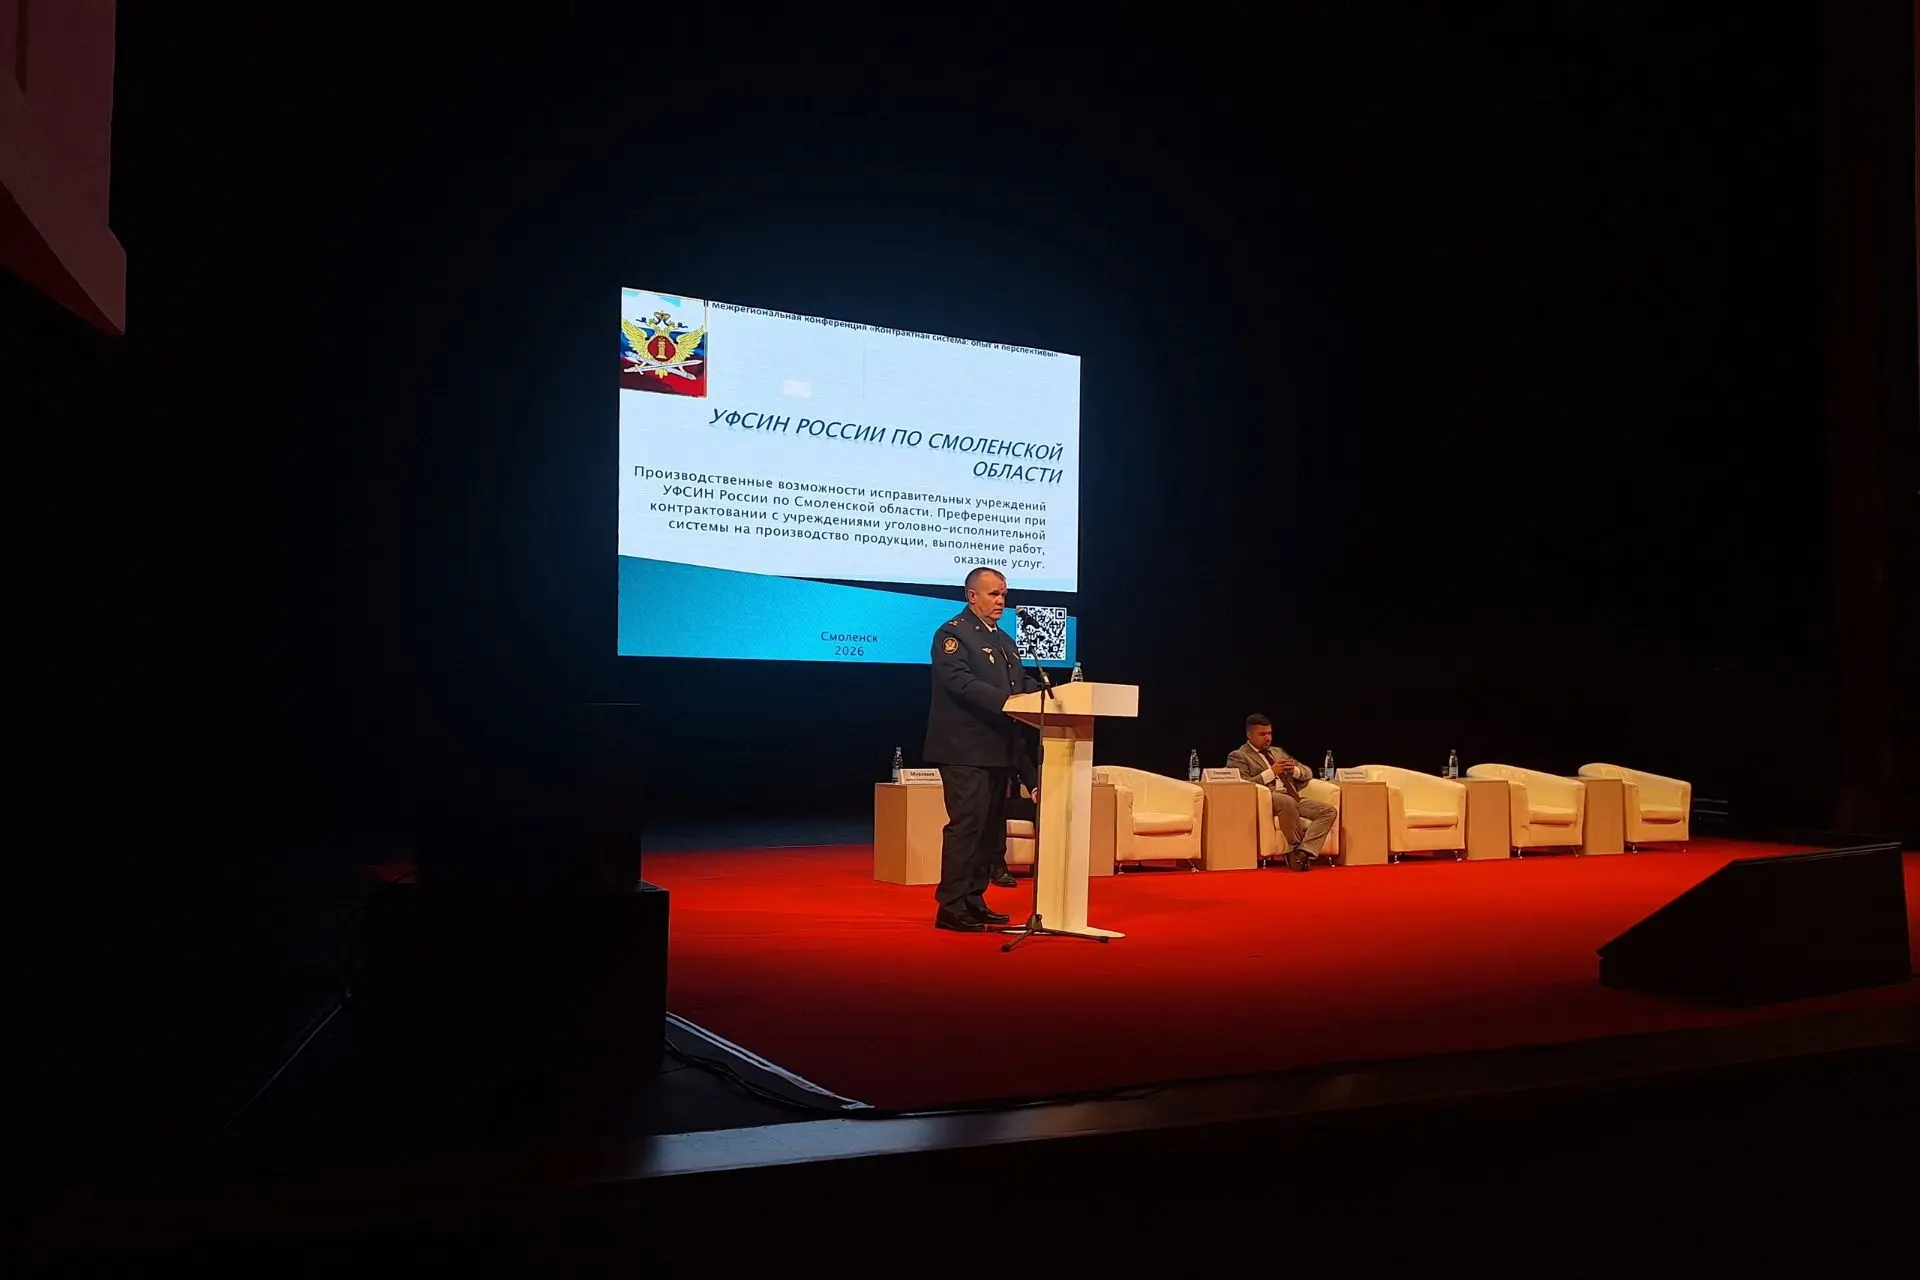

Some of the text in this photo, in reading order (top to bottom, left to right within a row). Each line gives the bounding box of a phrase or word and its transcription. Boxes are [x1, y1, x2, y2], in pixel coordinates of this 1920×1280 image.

[712, 302, 801, 321] межрегиональная
[804, 316, 867, 330] конференция
[870, 326, 930, 340] «Контрактная
[932, 334, 969, 346] система:
[971, 340, 992, 349] опыт
[1002, 344, 1058, 358] перспективы»
[709, 408, 1064, 461] УФСИН РОССИИ ПО СМОЛЕНСКОЙ
[634, 465, 1046, 512] Производственные возможности исправительных учреждений
[973, 461, 1064, 484] ОБЛАСТИ
[650, 502, 1046, 540] контрактовании с учреждениями уголовно-исполнительной
[662, 484, 1046, 527] УФСИН России по Смоленской области. Преференции при
[668, 520, 1045, 556] системы на производство продукции, выполнение работ,
[954, 555, 1045, 570] оказание услуг.
[820, 631, 878, 642] Смоленск
[835, 646, 864, 656] 2026
